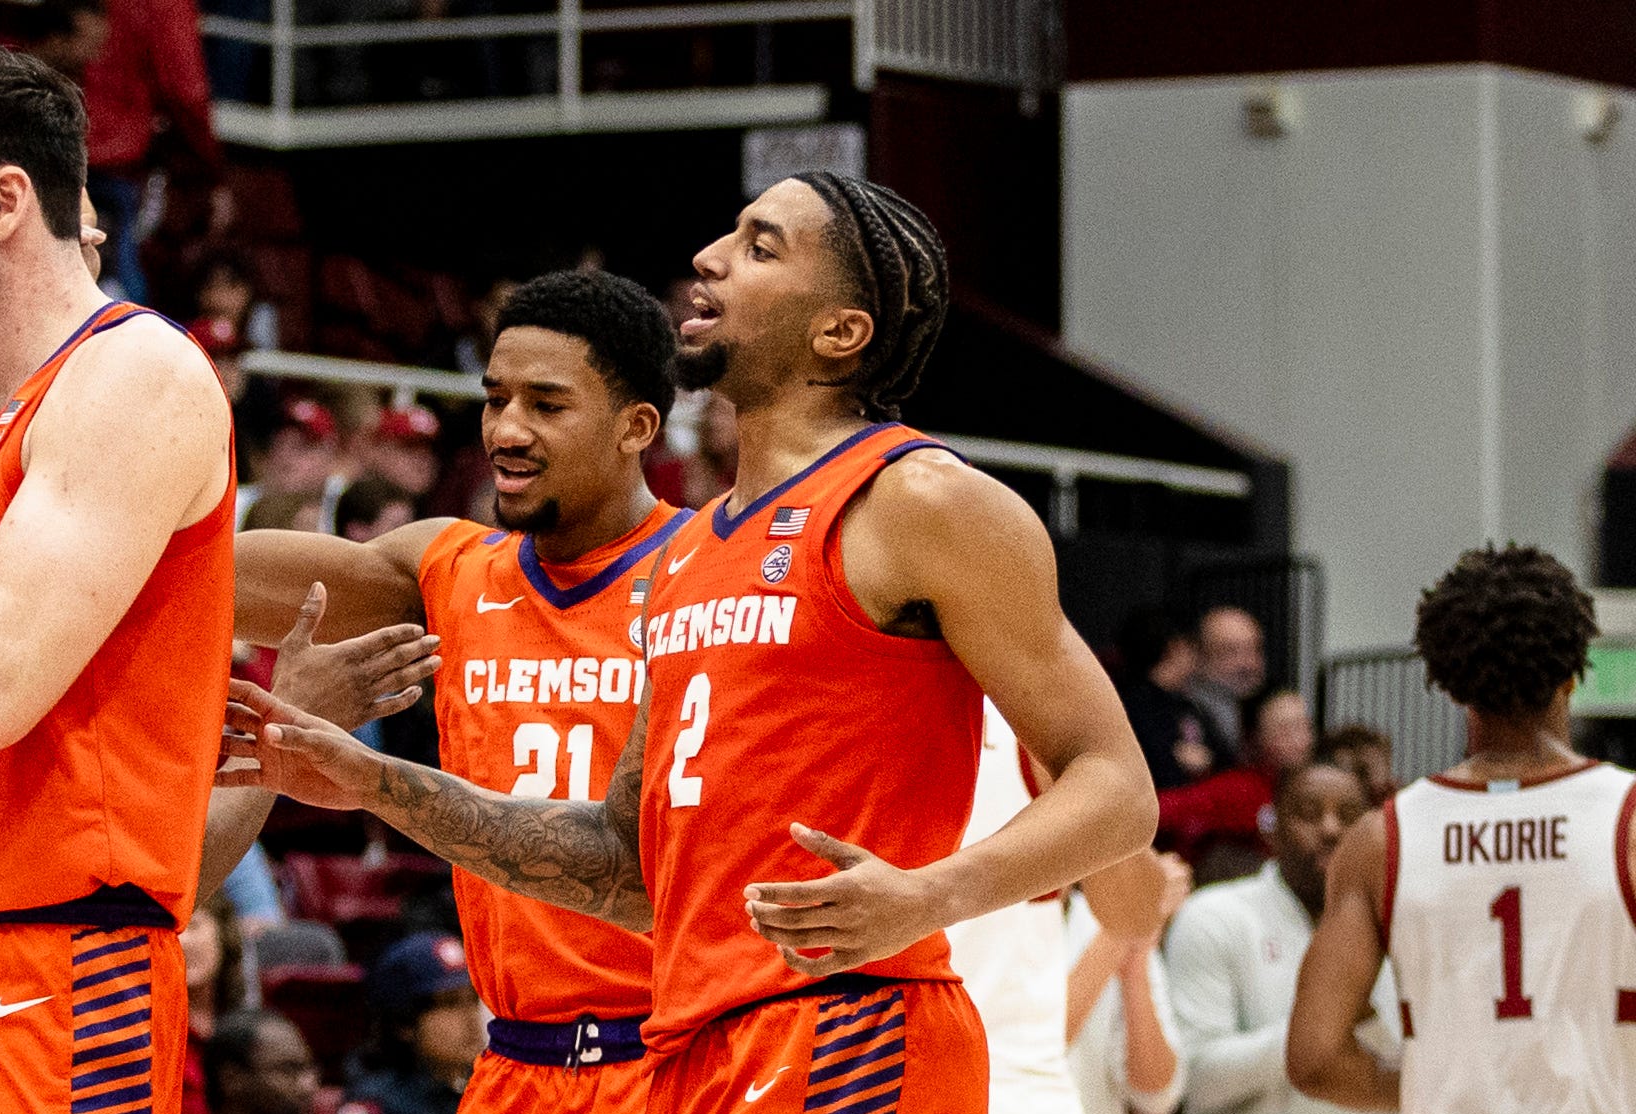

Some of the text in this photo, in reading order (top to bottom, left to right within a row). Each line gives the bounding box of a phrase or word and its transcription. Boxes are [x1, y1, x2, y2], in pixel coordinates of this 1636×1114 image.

[647, 595, 797, 665] CLEMSON
[511, 723, 594, 801] 21
[668, 672, 711, 808] 2
[1443, 816, 1568, 864] OKORIE
[1489, 886, 1533, 1020] 1
